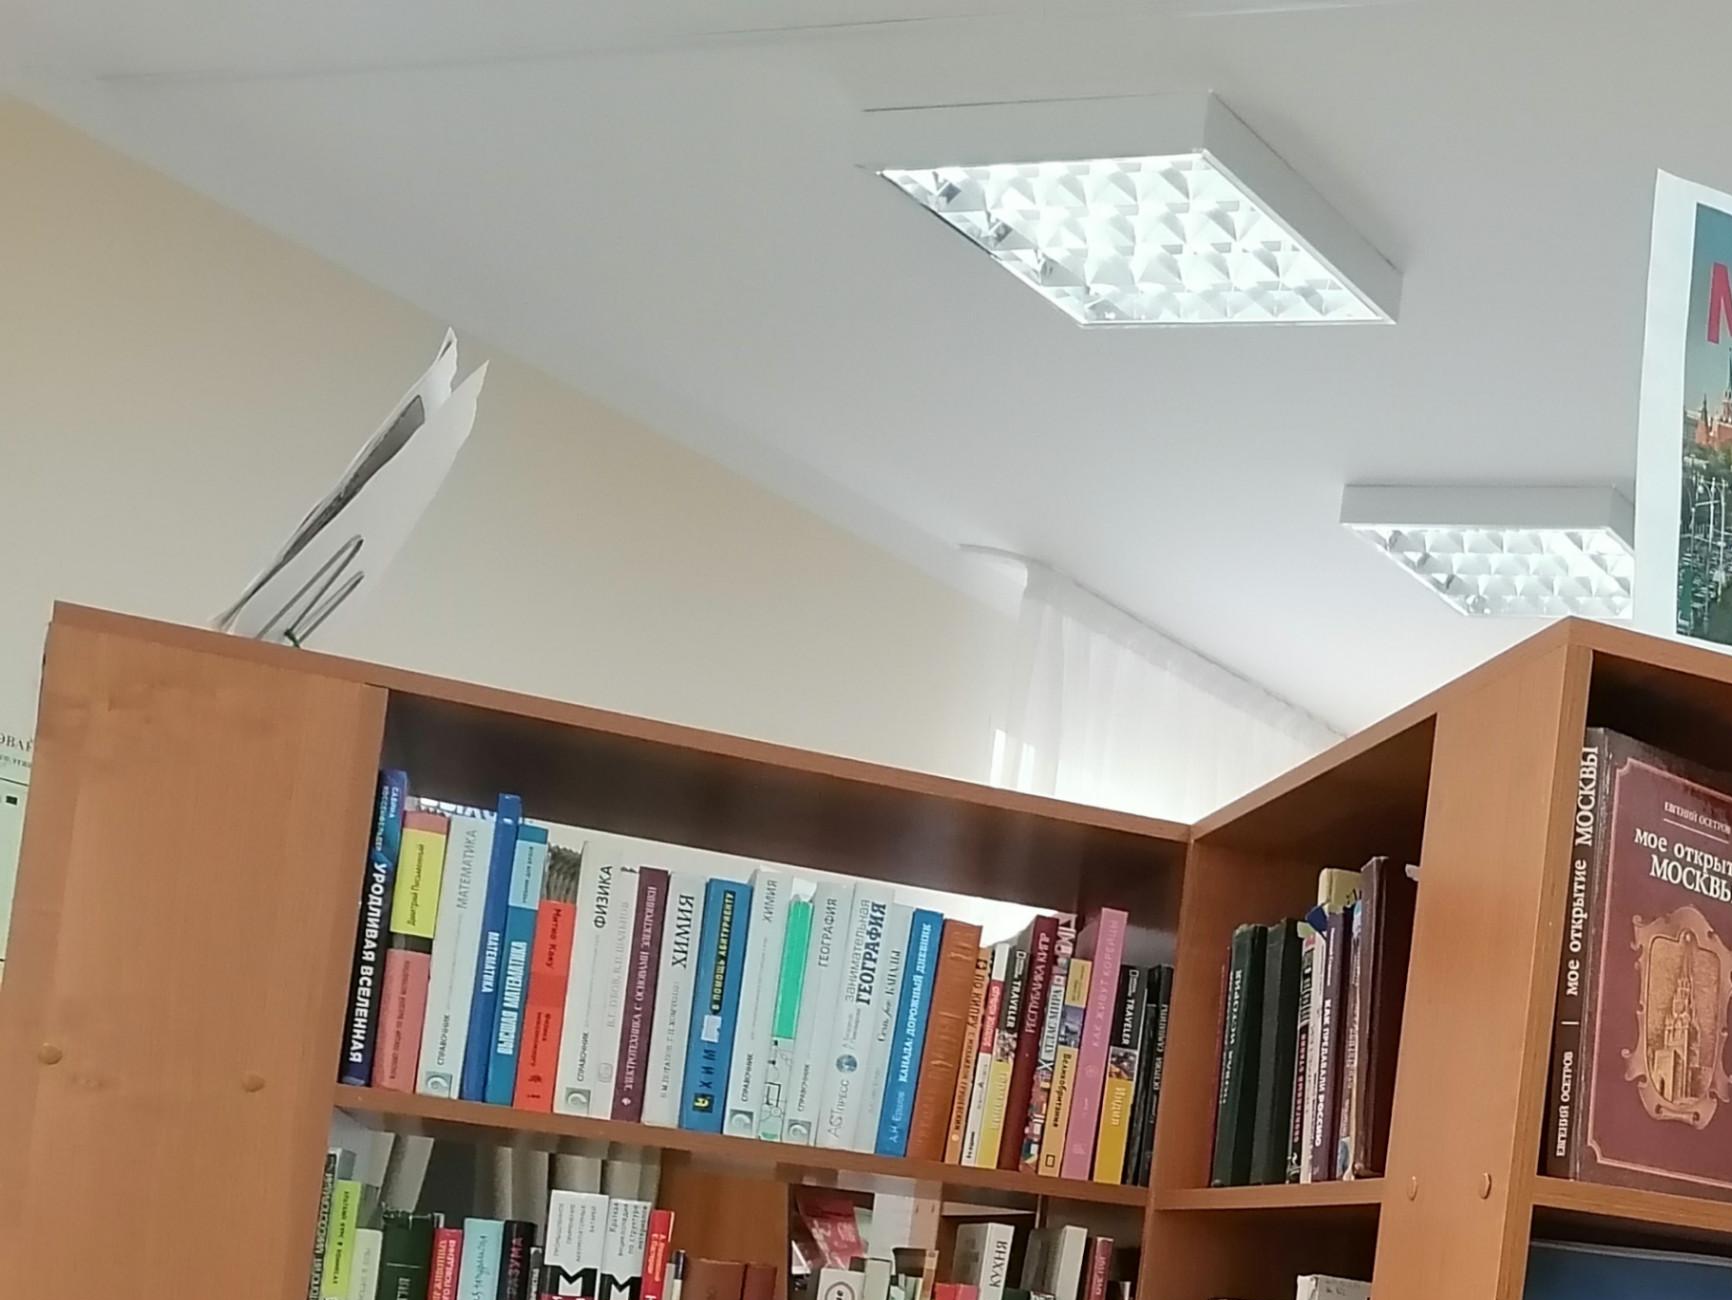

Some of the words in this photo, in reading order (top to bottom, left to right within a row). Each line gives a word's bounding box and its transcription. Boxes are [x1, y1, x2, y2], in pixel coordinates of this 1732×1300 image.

[1575, 745, 1598, 847] МОСКВЫ
[1699, 815, 1731, 835] ОСЕТРОВ
[456, 829, 478, 909] МАТЕМАТИКА
[1634, 828, 1667, 851] мое
[361, 863, 387, 961] УРОДЛИВАЯ
[549, 908, 562, 940] Митио
[671, 894, 694, 969] ХИМИЯ
[718, 892, 734, 956] АБИТУРИЕНТУ
[817, 897, 838, 968] ГЕОГРАФИЯ
[1568, 859, 1586, 952] открытие
[480, 932, 499, 993] МАТЕМАТИКА
[506, 941, 527, 1008] МАТЕМАТИКА
[544, 943, 558, 969] Каку
[576, 1031, 590, 1082] СПРАВОЧНИК
[592, 865, 614, 929] ФИЗИКА
[856, 901, 886, 1005] ГЕОГРАФИЯ
[1034, 932, 1050, 963] КИПР
[1566, 959, 1580, 996] мое
[712, 960, 726, 1001] ПОМОЩЬ
[741, 1053, 754, 1102] СПРАВОЧНИК
[762, 879, 779, 924] ХИМИЯ
[1006, 981, 1022, 1028] TRAVELER
[1025, 965, 1046, 1033] РЕСПУБЛИКА
[1050, 988, 1062, 1021] МИРА
[348, 966, 374, 1063] ВСЕЛЕННАЯ
[496, 1011, 517, 1055] ВЫСШАЯ
[1121, 999, 1135, 1045] TRAVELER
[1052, 1053, 1072, 1128] Великобритания
[1561, 1051, 1574, 1101] ОСЕТРОВ
[1315, 1091, 1325, 1148] РОССИЮ
[504, 1237, 524, 1298] РАЗУМА
[989, 1240, 1008, 1288] КУХНЯ
